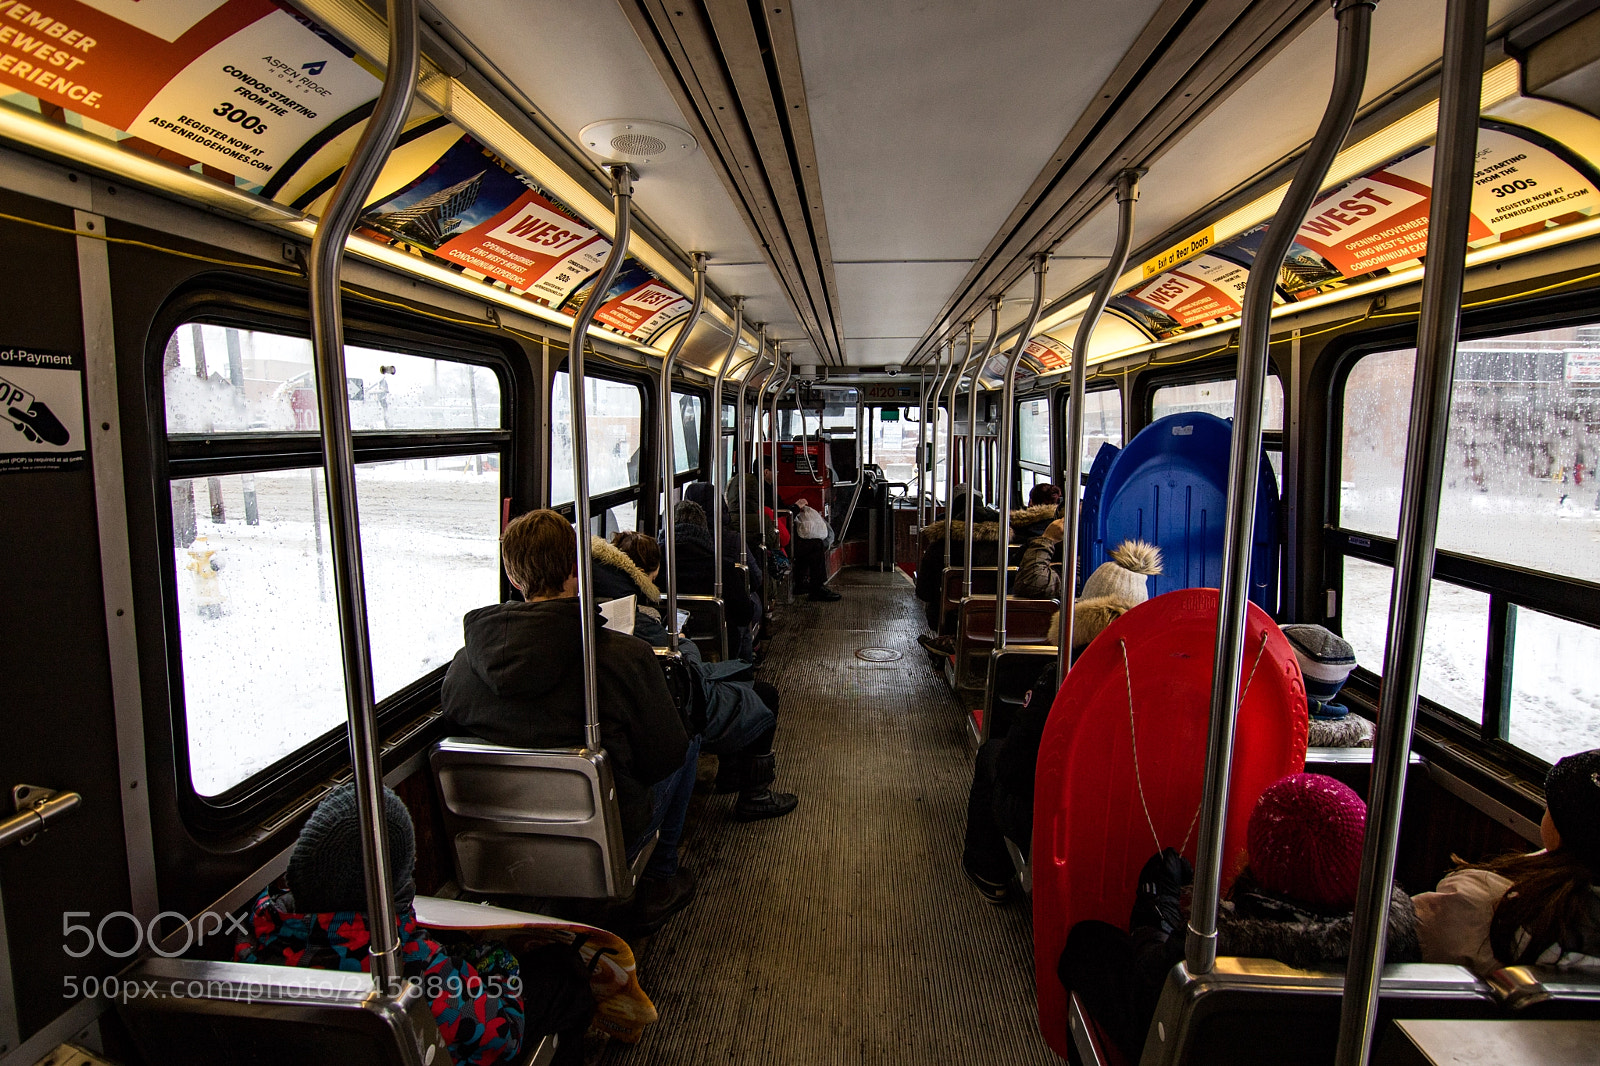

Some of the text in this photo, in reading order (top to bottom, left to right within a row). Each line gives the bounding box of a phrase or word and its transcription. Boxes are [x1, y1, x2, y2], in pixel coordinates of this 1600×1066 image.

[0, 23, 85, 71] EWEST
[0, 53, 103, 109] ERIENCE.
[222, 65, 317, 119] CONDOS STARTING
[262, 55, 332, 97] ASPEN RIDGE
[234, 86, 289, 117] FROM THE
[212, 102, 268, 135] 300s
[149, 116, 273, 173] ASPENRIDGEHOMES.COM
[177, 115, 265, 157] REGISTER NOW AT
[1475, 167, 1519, 186] FROM THE
[1484, 153, 1527, 174] STARTING
[1491, 178, 1537, 198] 300s
[1496, 187, 1564, 214] REGISTER NOW AT
[1301, 187, 1393, 237] WEST
[1490, 188, 1590, 224] ASPENRIDGEHOMES.COM
[506, 214, 584, 249] WEST
[1345, 216, 1429, 251] OPENING NOVEMBER
[1353, 228, 1429, 259] KING WEST'S NEWE
[482, 241, 511, 258] OPENING
[1158, 257, 1167, 270] Exit
[1169, 253, 1175, 264] at
[1176, 246, 1190, 260] Rear
[1191, 235, 1209, 252] Doors
[1350, 248, 1410, 272] CONDOMINIUM
[633, 289, 674, 306] WEST
[1146, 277, 1190, 305] WEST
[869, 387, 896, 398] 4120
